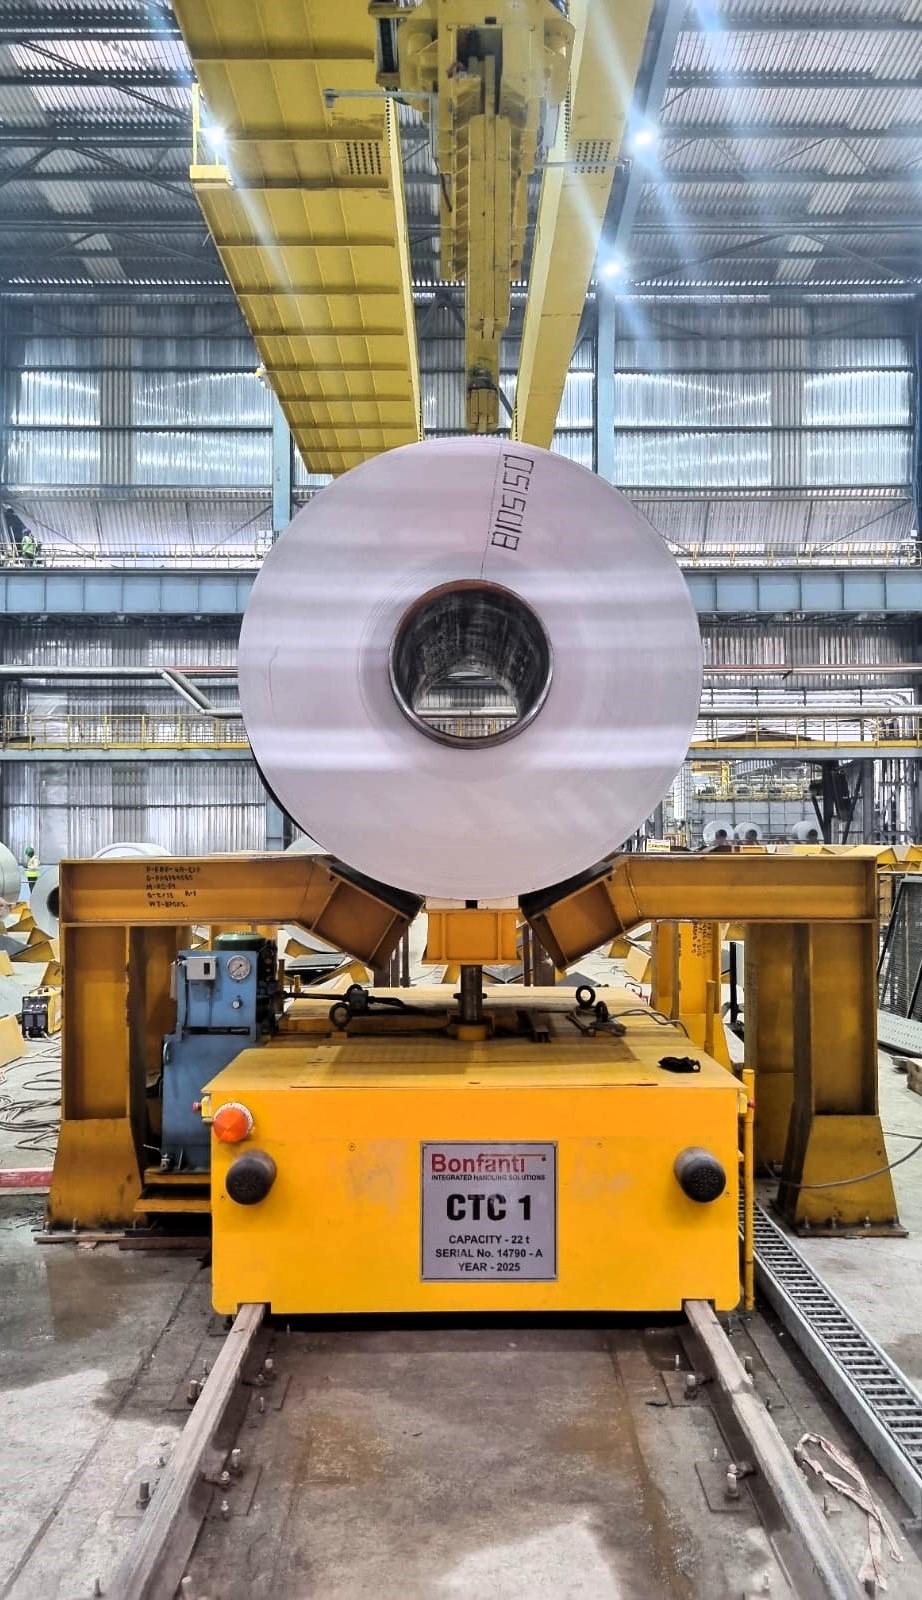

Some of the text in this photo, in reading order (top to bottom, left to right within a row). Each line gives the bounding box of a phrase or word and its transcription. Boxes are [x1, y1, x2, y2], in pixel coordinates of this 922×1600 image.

[431, 1153, 526, 1173] Bonfanti
[446, 1193, 532, 1221] CTC 1
[448, 1234, 503, 1245] CAPACITY
[511, 1234, 524, 1244] 22
[525, 1234, 531, 1244] t
[435, 1248, 474, 1258] SERIAL
[476, 1248, 494, 1258] No.
[497, 1248, 527, 1258] 14790
[534, 1248, 544, 1258] A
[458, 1262, 488, 1272] YEAR
[496, 1262, 521, 1272] 2025
